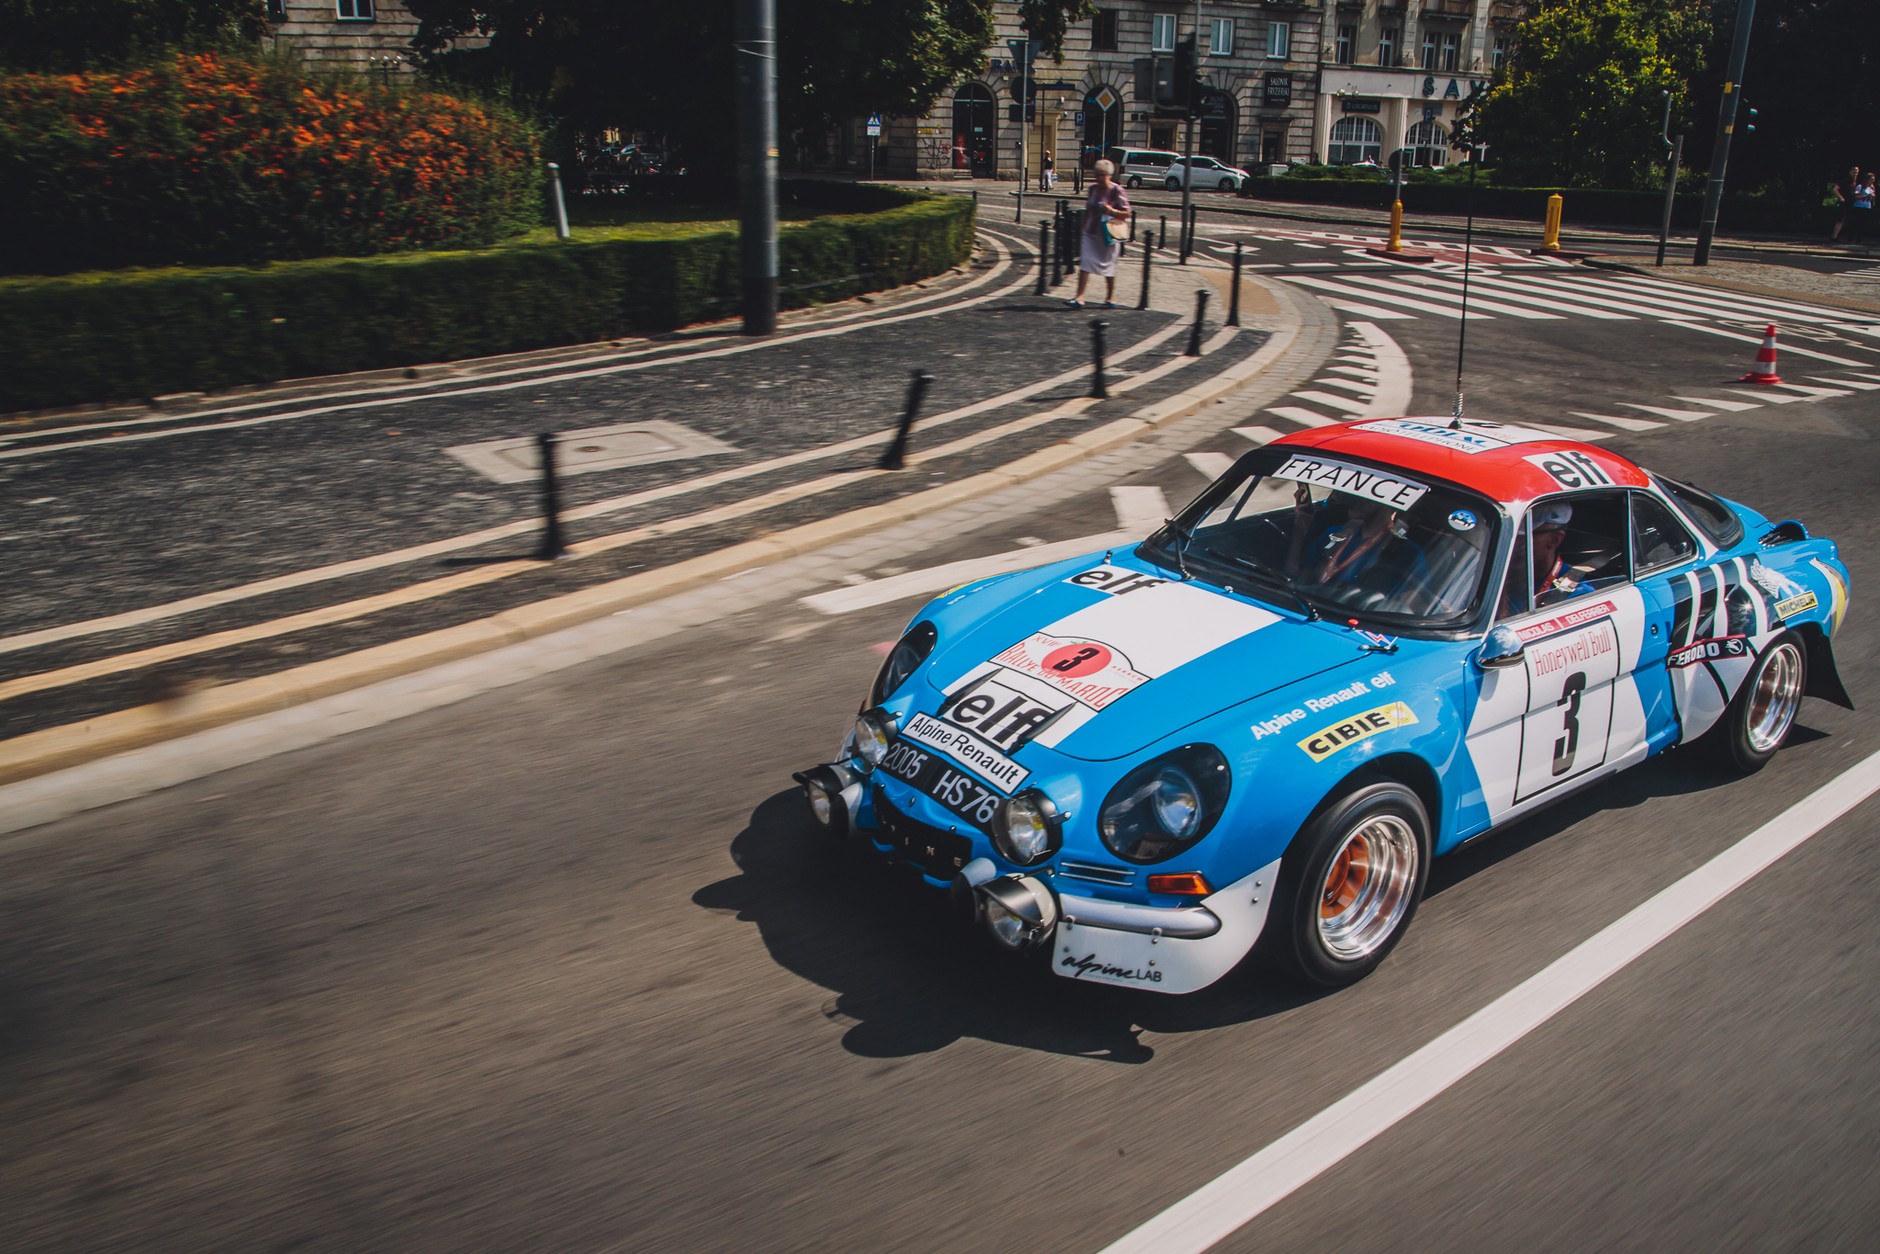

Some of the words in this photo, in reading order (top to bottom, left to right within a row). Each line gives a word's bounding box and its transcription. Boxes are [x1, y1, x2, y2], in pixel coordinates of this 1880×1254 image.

[1280, 458, 1420, 506] FRANCE
[1543, 451, 1610, 488] elf
[1071, 570, 1169, 595] elf
[1779, 595, 1816, 616] MICHELIN
[1518, 623, 1555, 641] NICOLAS
[1532, 638, 1590, 676] Honeywell
[1590, 626, 1612, 658] Bull
[996, 642, 1039, 671] RALLYE
[1055, 677, 1129, 708] MAROC
[1052, 647, 1100, 672] 3
[1667, 642, 1720, 666] FERODO
[953, 695, 1051, 745] elf
[1250, 708, 1307, 740] Alpine
[1304, 681, 1371, 713] Renault
[1371, 671, 1397, 689] elf
[1552, 671, 1587, 776] 3
[882, 742, 928, 779] 2005
[909, 716, 951, 743] Alpine
[950, 733, 1019, 784] Renault
